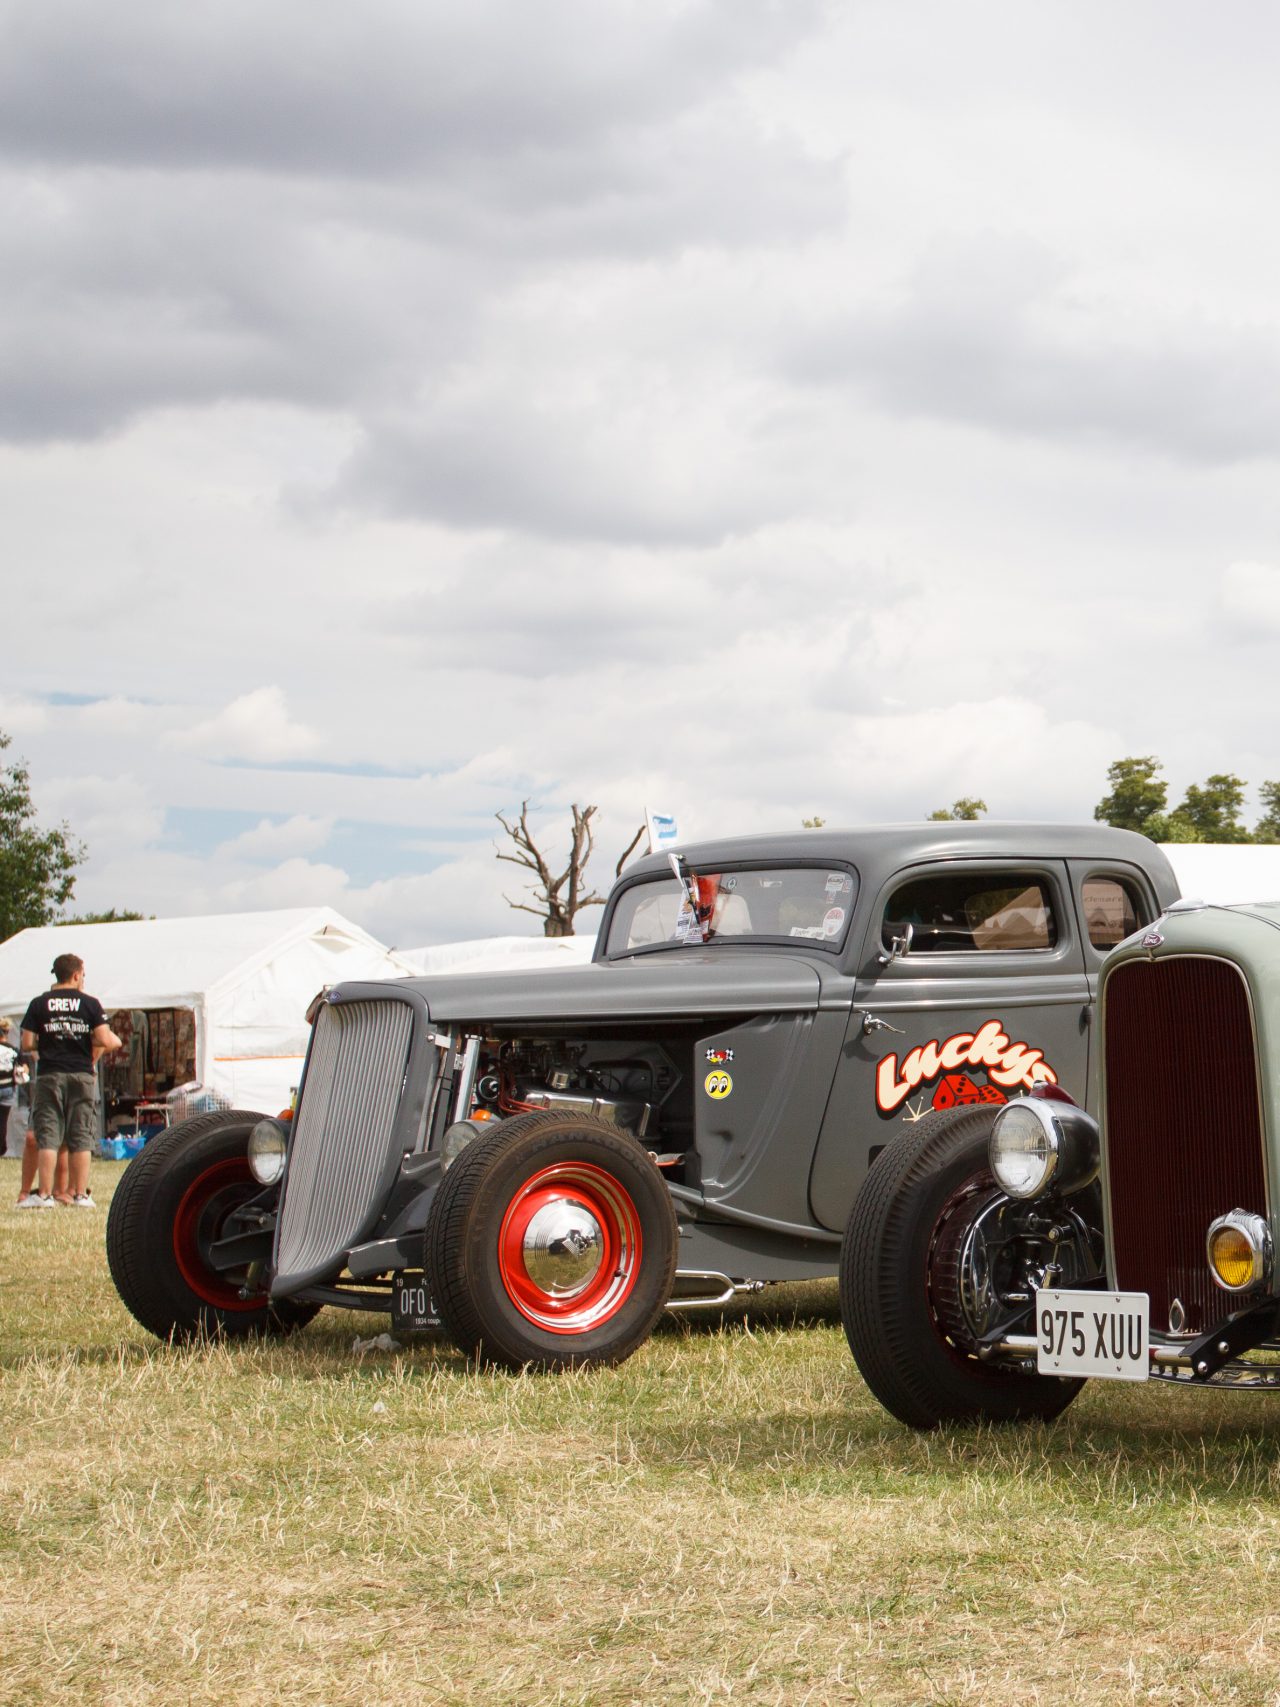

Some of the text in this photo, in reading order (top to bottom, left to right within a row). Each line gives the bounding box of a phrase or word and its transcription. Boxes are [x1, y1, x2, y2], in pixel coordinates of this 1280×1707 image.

[48, 998, 80, 1012] CREW
[396, 1278, 404, 1287] 19
[1041, 1309, 1142, 1361] 975 XUU
